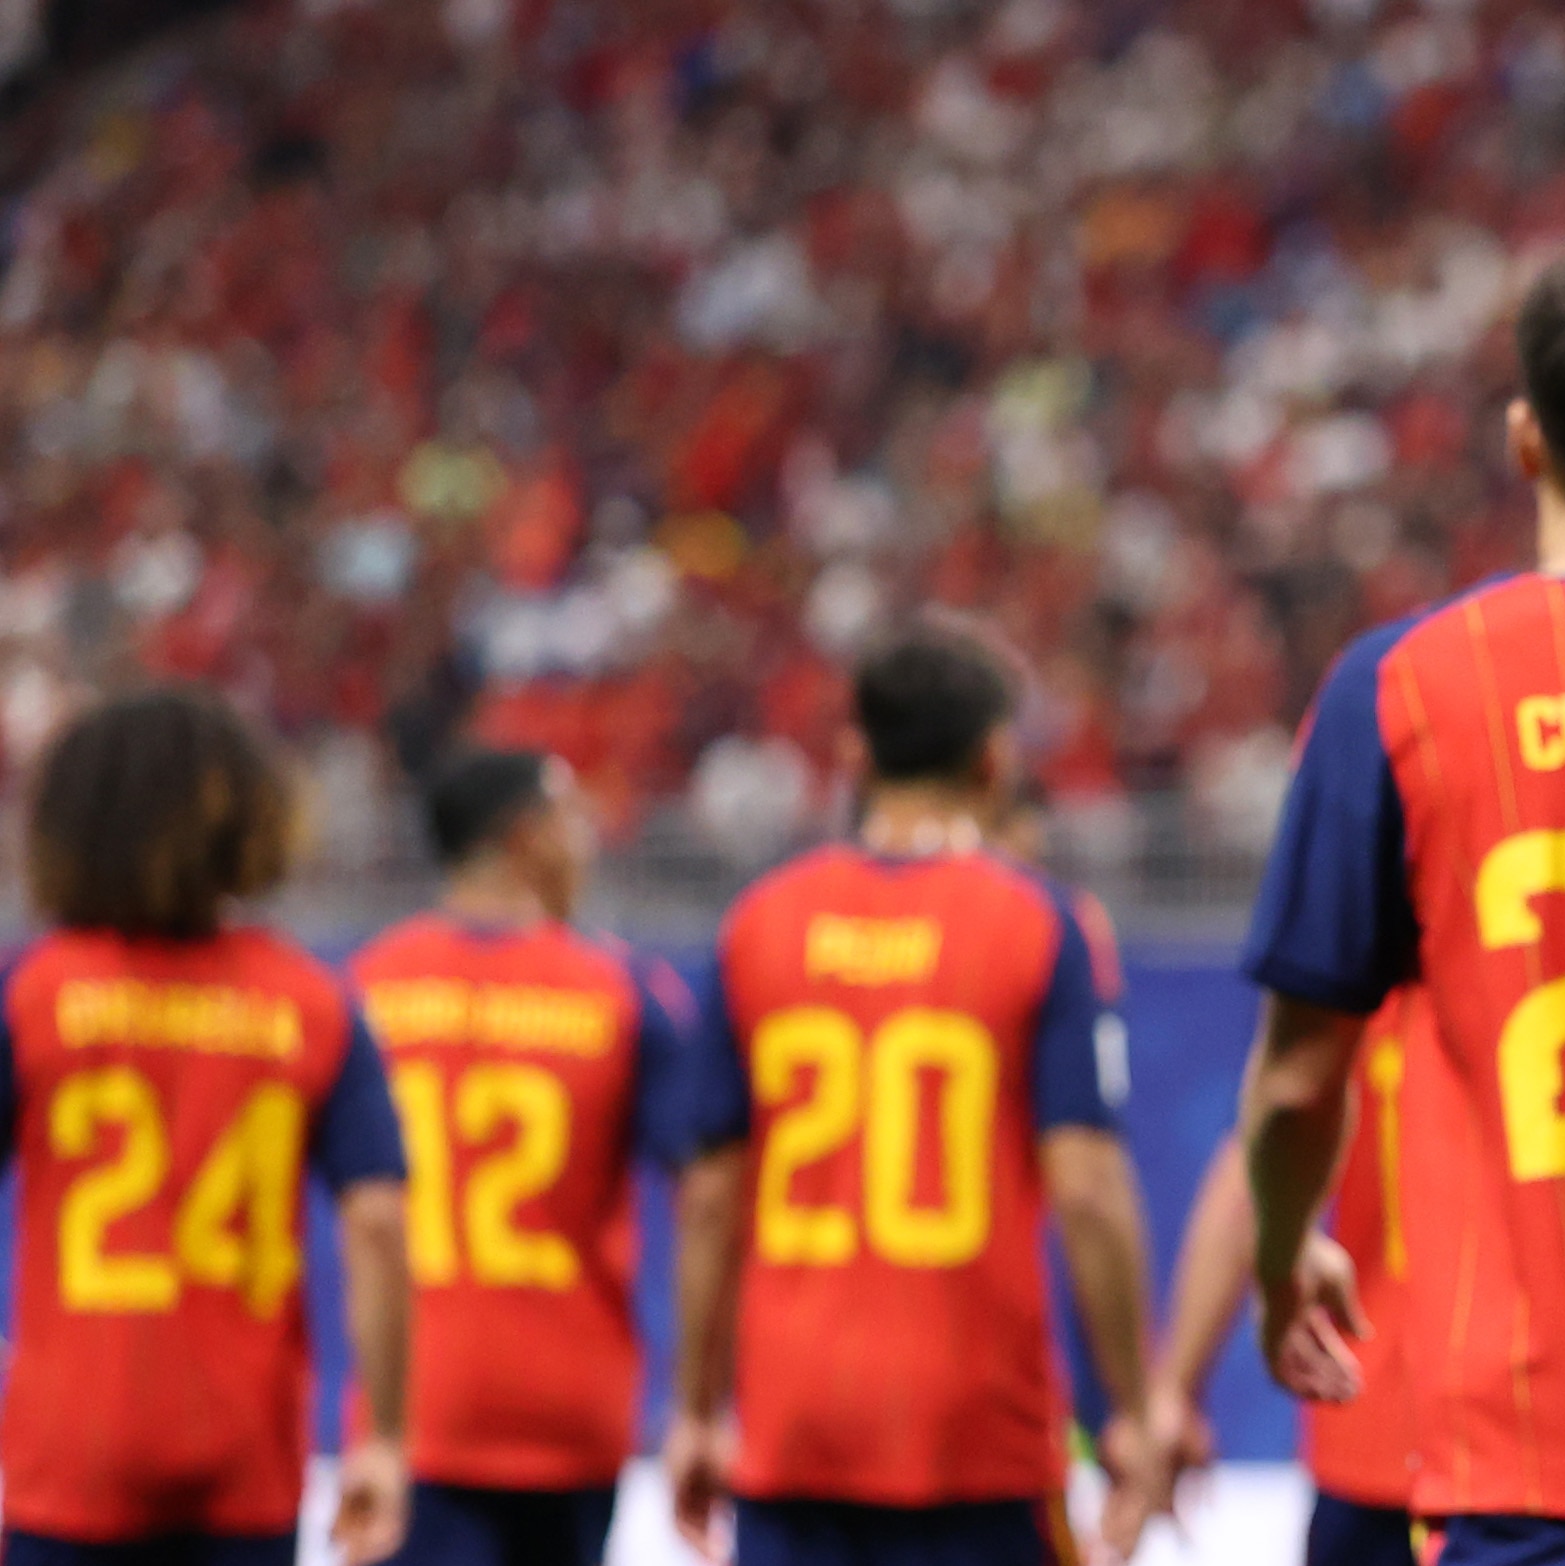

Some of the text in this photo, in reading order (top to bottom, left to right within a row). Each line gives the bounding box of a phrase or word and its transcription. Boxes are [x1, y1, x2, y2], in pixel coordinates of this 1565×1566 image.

[52, 1065, 308, 1321] 24
[392, 1062, 579, 1292] 12
[755, 1006, 997, 1267] 20
